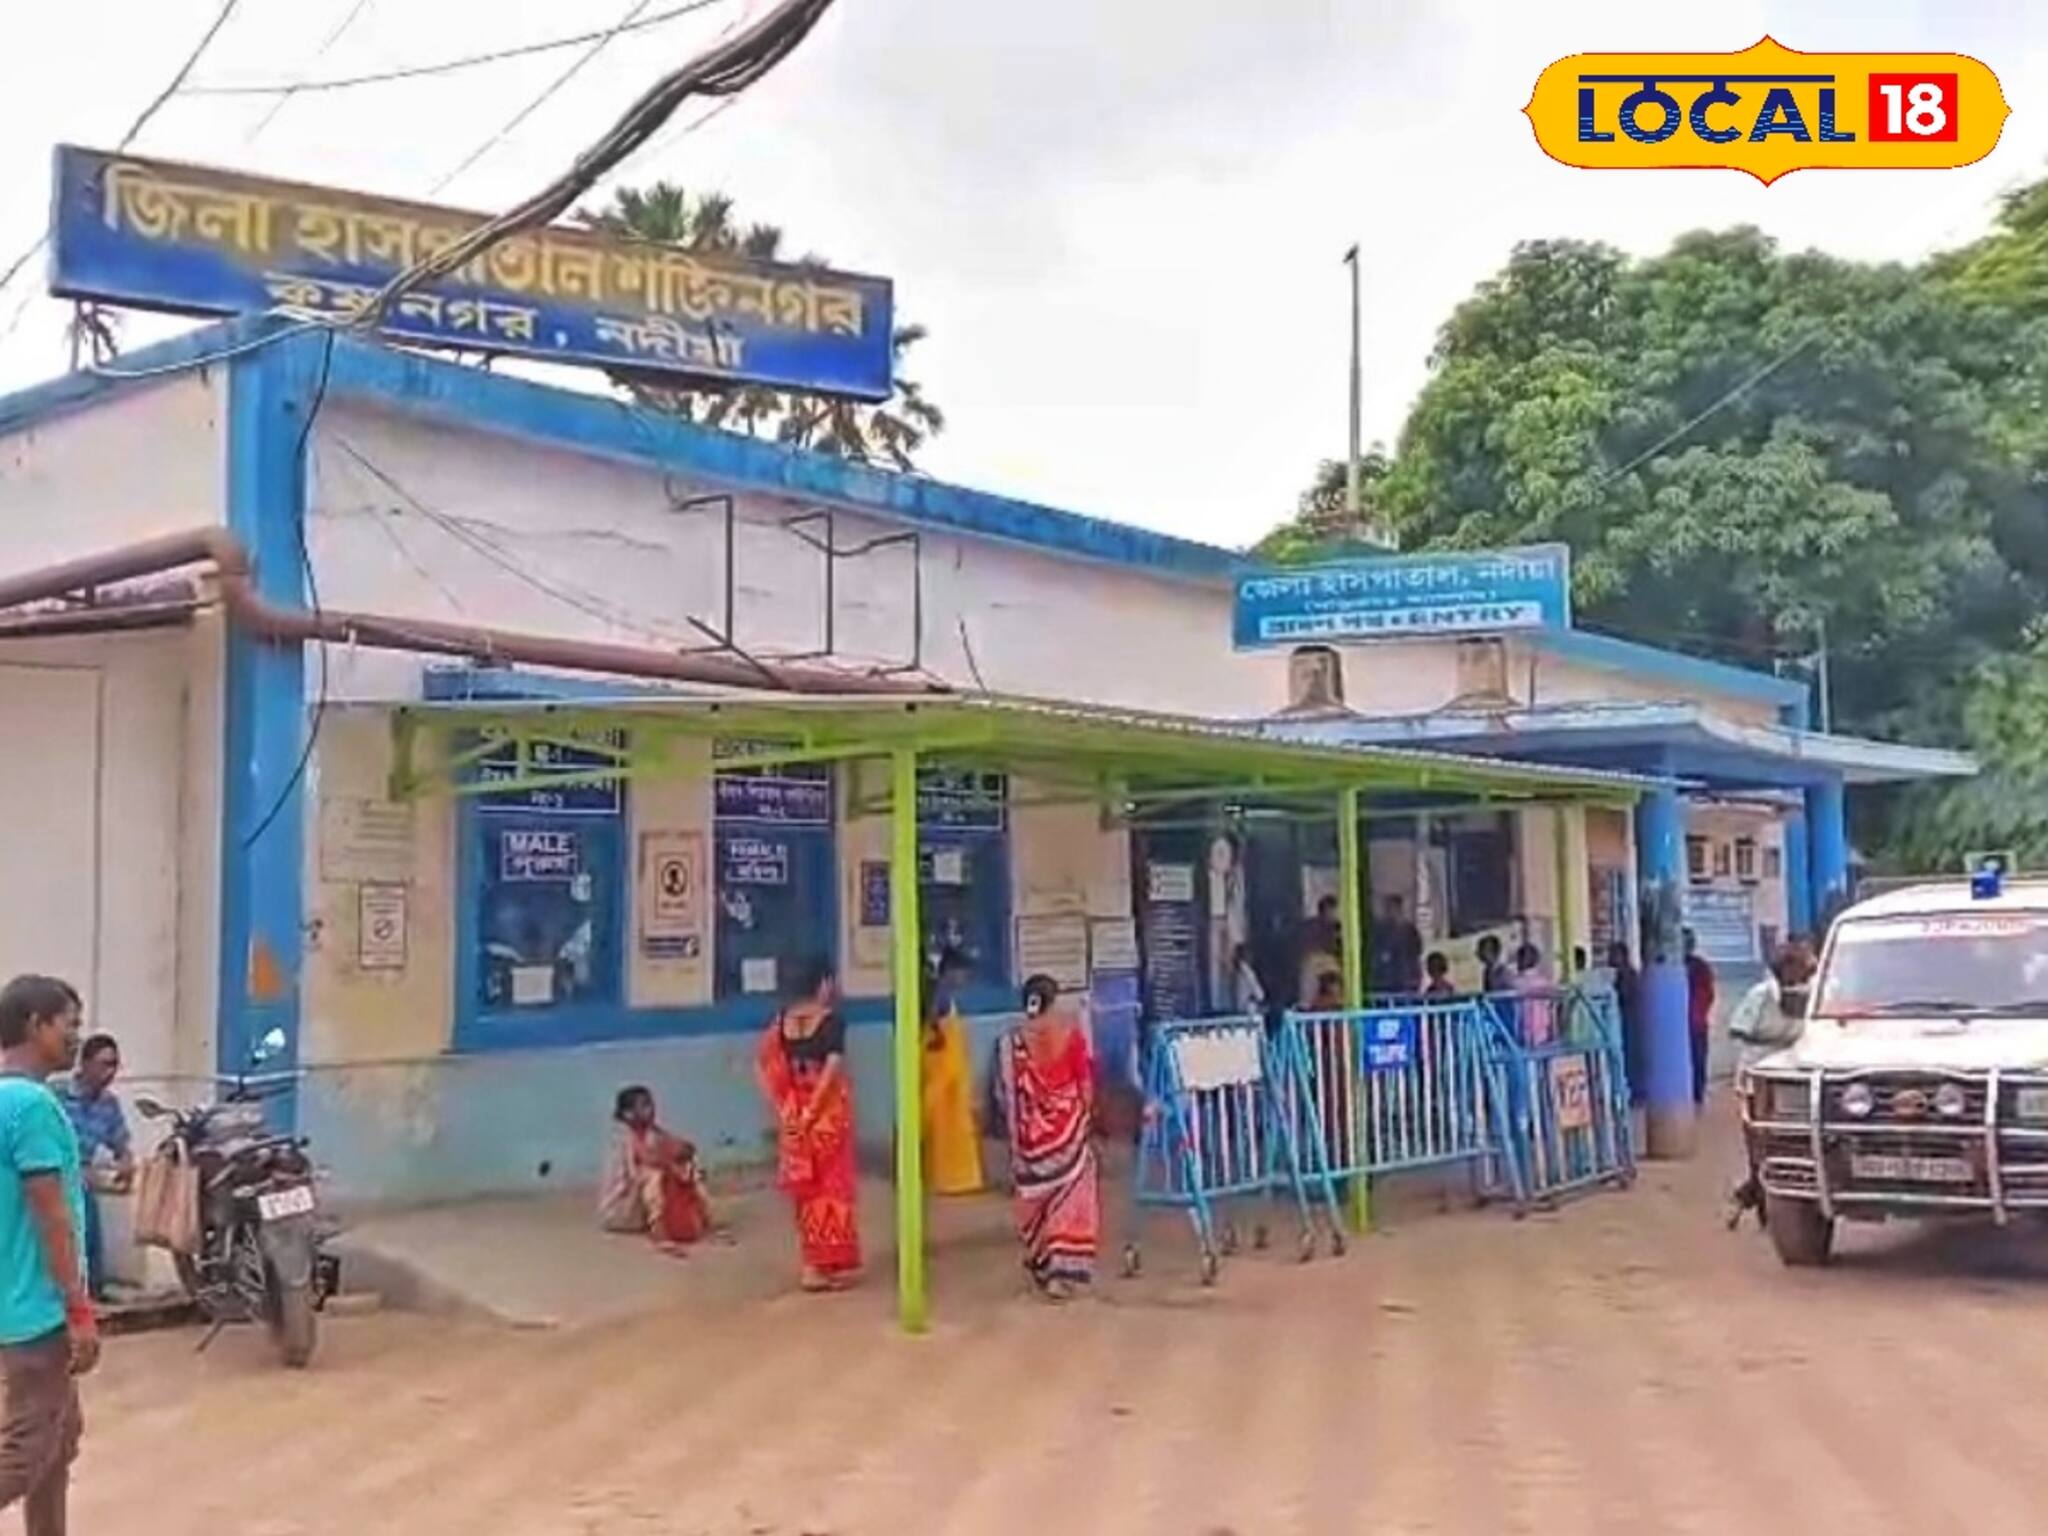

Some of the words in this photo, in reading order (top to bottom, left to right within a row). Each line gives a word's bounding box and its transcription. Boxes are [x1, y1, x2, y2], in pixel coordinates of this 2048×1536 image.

[104, 160, 272, 253] জিলা
[608, 249, 864, 338] শক্তিনগর
[1408, 606, 1524, 625] ENTRY
[510, 834, 571, 852] MALE
